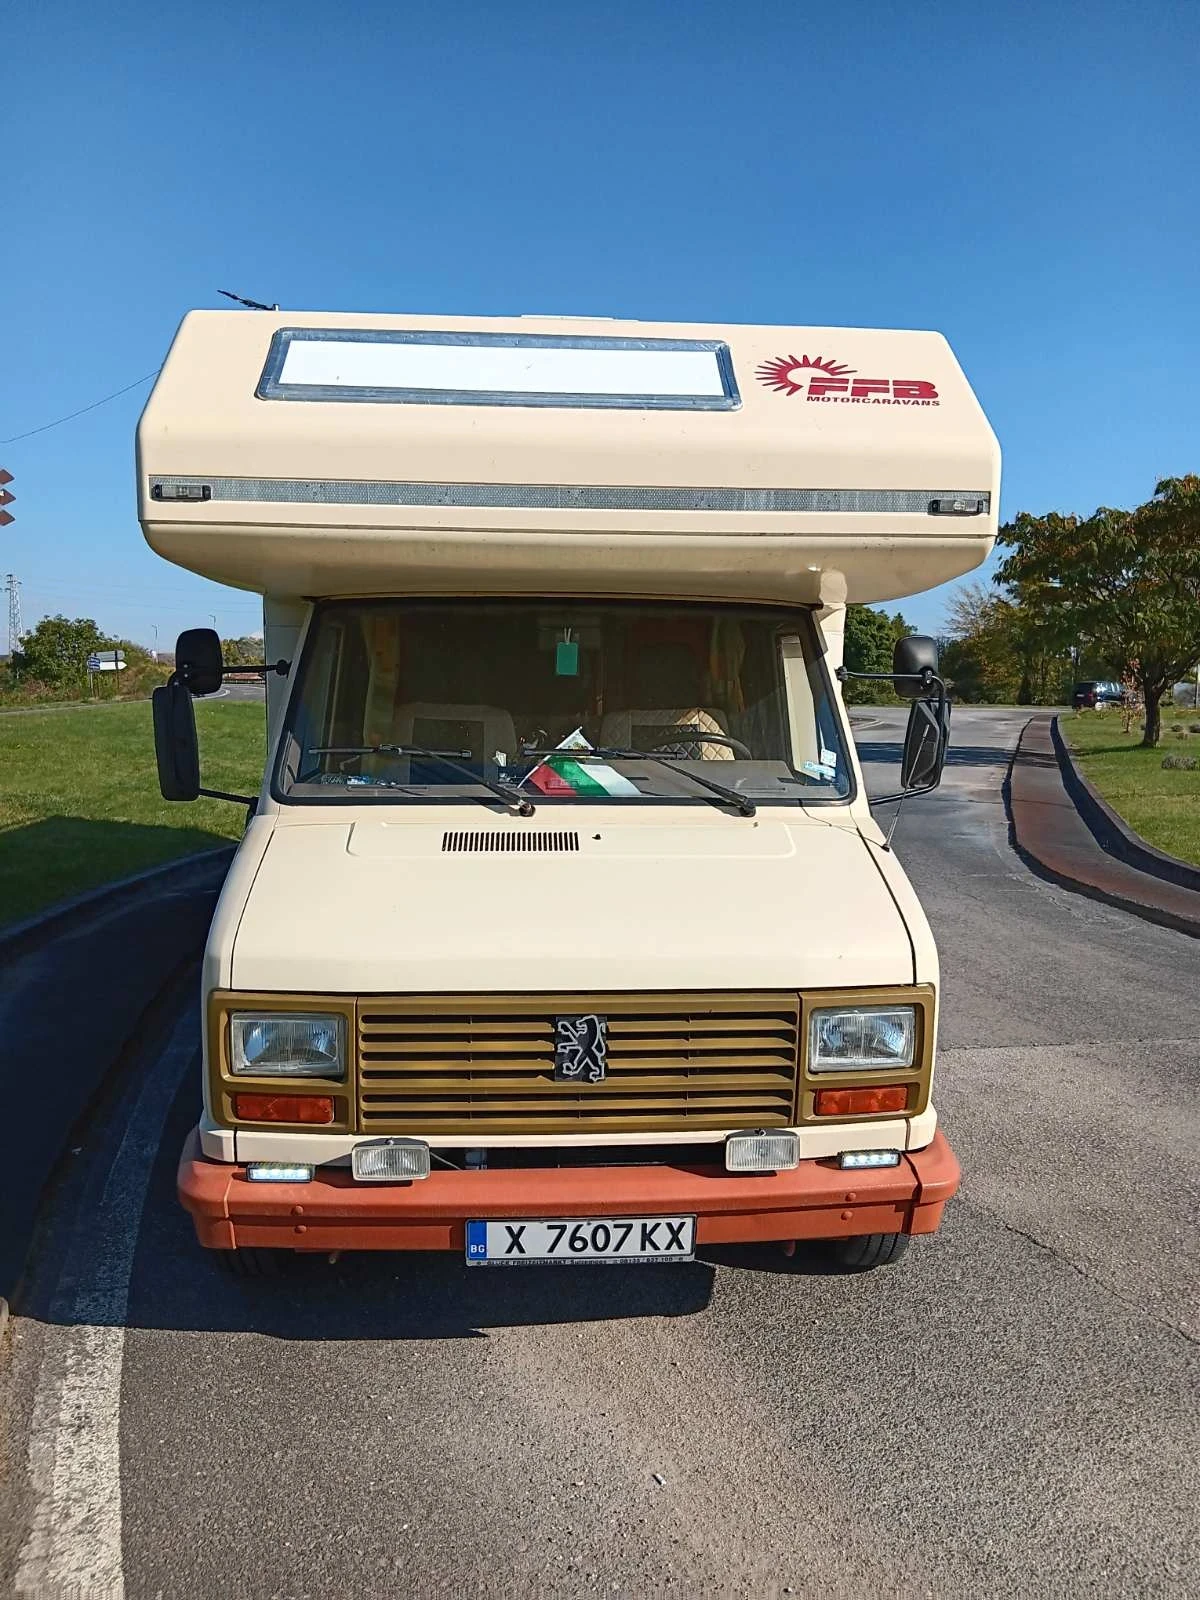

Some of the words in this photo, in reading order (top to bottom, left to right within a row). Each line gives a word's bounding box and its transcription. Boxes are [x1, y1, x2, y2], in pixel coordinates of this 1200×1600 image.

[808, 377, 938, 399] FFB
[806, 396, 940, 406] MOTORCARAVANS
[505, 1225, 526, 1254] X
[546, 1223, 634, 1253] 7607
[639, 1221, 686, 1251] KX
[470, 1244, 485, 1253] BG
